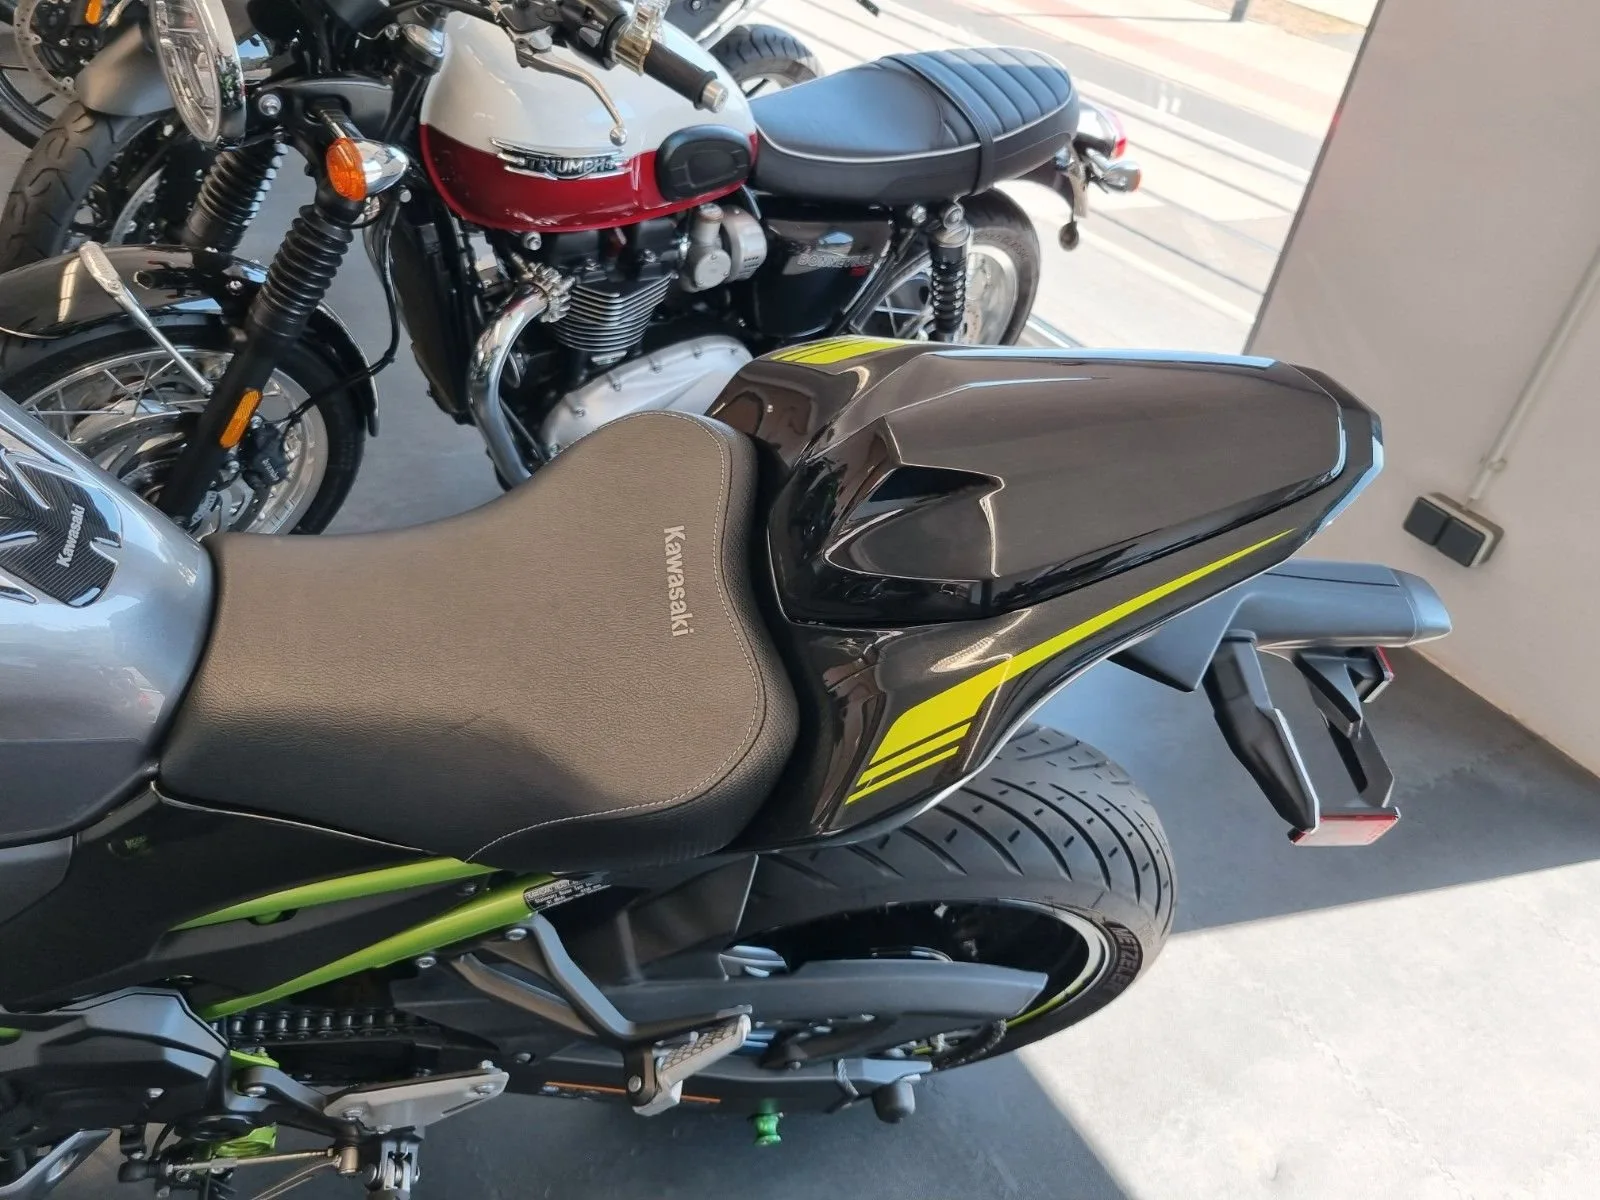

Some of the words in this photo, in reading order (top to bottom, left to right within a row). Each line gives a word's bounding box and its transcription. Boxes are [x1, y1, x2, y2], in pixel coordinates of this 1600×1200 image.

[528, 156, 607, 176] TRIUMPH
[56, 503, 85, 568] Kawasaki
[663, 525, 695, 637] Kawasaki
